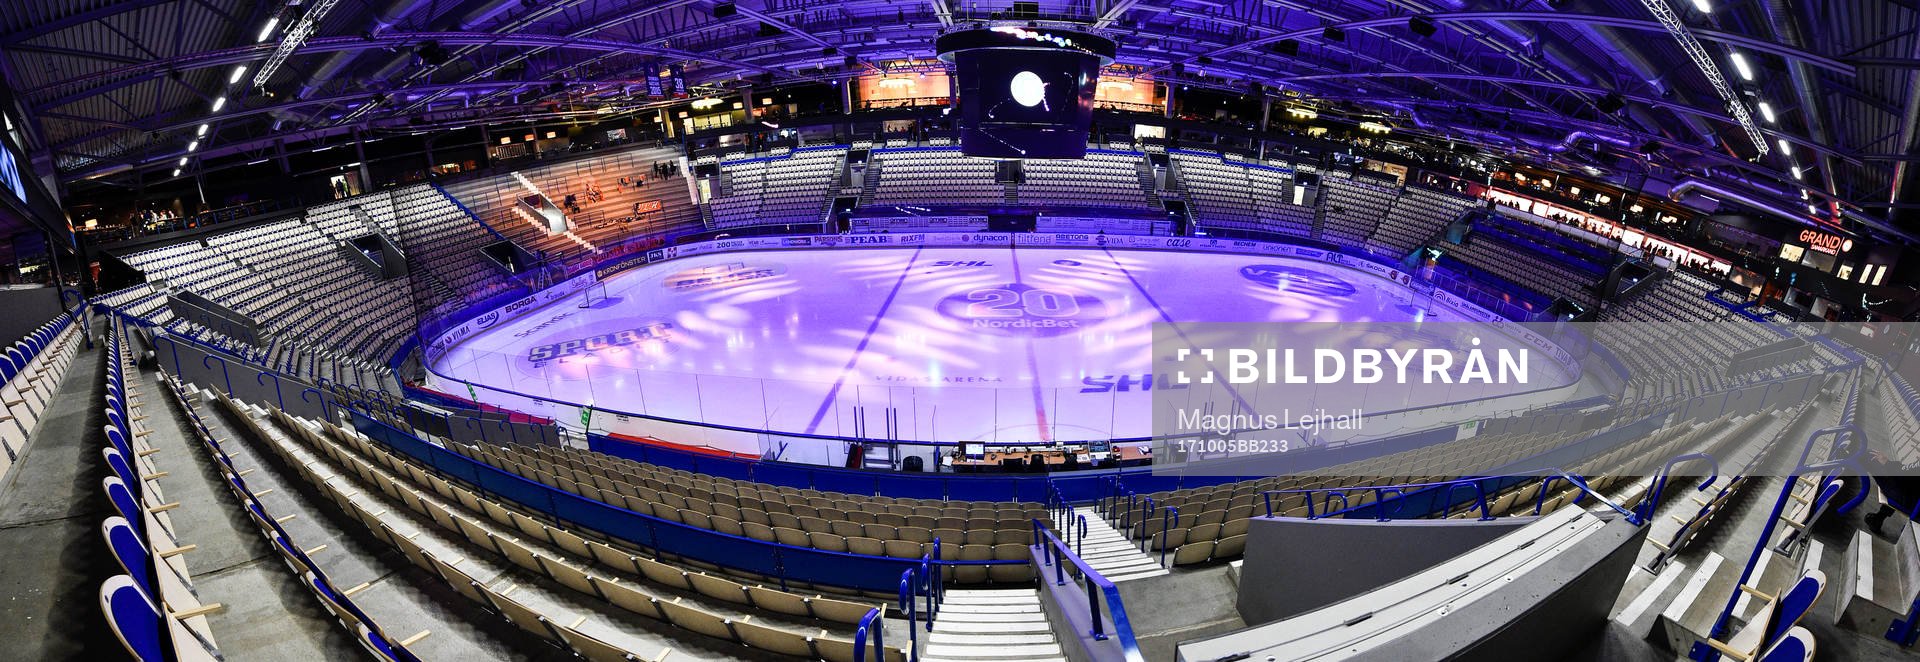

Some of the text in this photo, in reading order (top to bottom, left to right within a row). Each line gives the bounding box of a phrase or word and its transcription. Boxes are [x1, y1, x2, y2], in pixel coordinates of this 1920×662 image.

[716, 241, 731, 249] 200
[850, 235, 888, 244] PEAB
[972, 233, 1009, 243] dynacon
[1166, 238, 1192, 248] case
[1800, 229, 1841, 250] GRAND
[504, 295, 538, 314] BORGA
[967, 288, 1081, 318] 20
[972, 318, 1081, 329] NordicBet
[528, 322, 673, 363] SPORT
[1080, 373, 1189, 394] SHL
